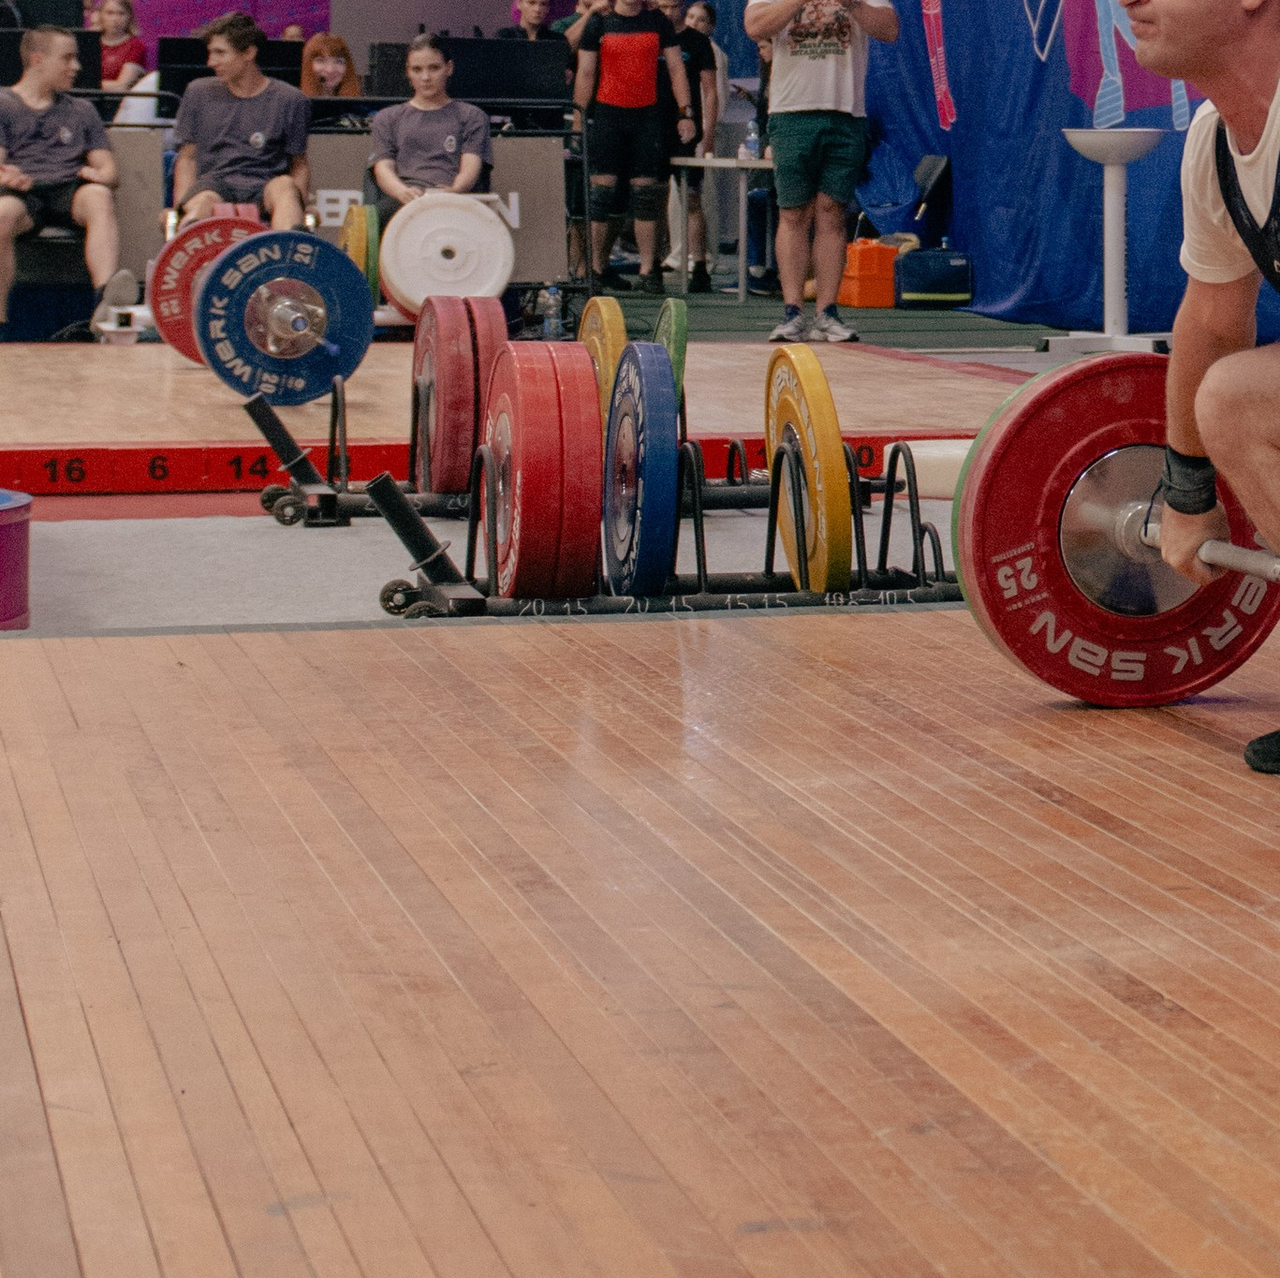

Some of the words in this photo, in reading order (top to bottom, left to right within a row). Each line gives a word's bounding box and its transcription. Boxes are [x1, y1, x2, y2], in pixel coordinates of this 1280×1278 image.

[43, 456, 86, 483] 16
[147, 455, 169, 480] 6
[227, 454, 270, 480] 14
[997, 556, 1038, 600] 25
